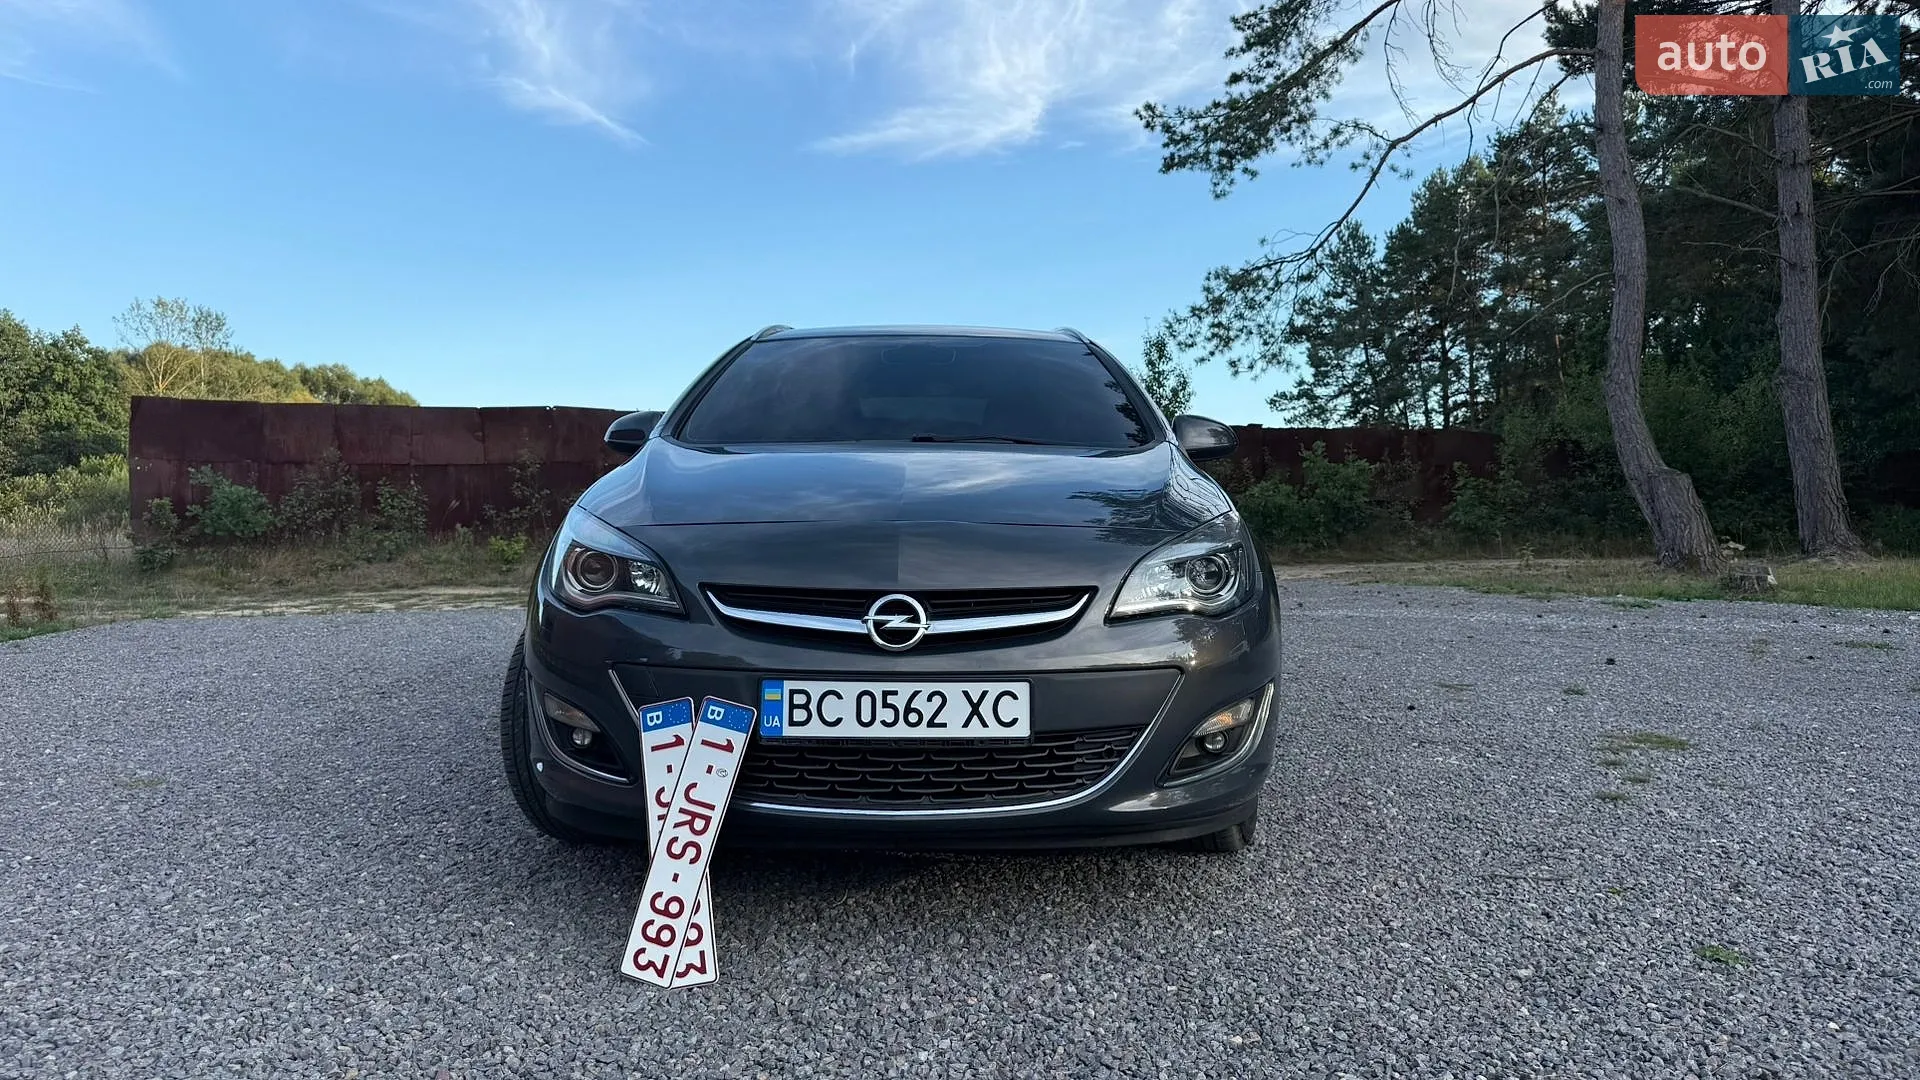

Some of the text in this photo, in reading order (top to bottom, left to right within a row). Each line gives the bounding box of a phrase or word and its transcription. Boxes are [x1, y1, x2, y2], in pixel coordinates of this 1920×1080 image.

[708, 705, 724, 720] B
[787, 688, 1019, 728] BC 0562 XC
[646, 711, 662, 726] B
[763, 715, 780, 727] UA
[632, 737, 735, 979] 1-JRS-993
